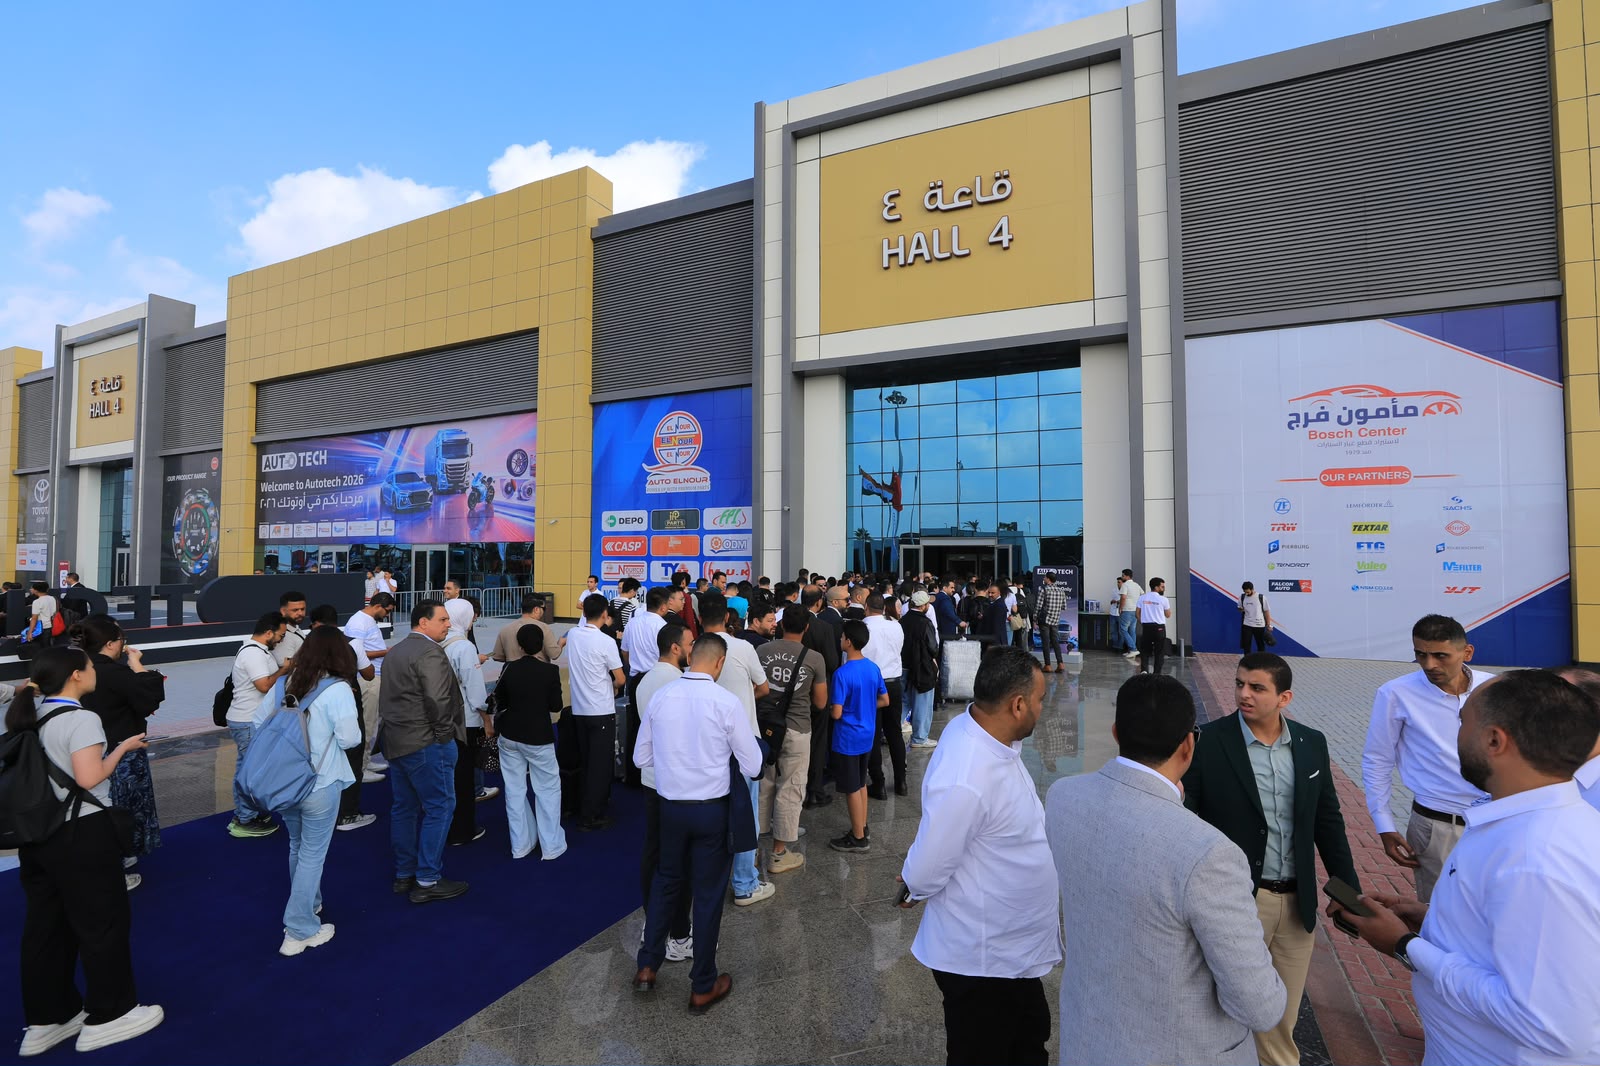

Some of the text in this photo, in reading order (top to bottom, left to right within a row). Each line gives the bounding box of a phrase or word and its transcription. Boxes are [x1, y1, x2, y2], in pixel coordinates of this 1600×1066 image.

[882, 169, 1013, 222] قاعة ٤
[882, 214, 1014, 270] HALL 4
[90, 375, 122, 396] قاعة ٤
[90, 397, 122, 419] HALL 4
[1287, 397, 1419, 431] مأمون فرج
[1308, 426, 1407, 440] Bosch Center
[262, 449, 328, 472] AUTO TECH
[176, 473, 193, 481] PRODUCT
[193, 472, 207, 480] RANGE
[648, 478, 671, 486] AUTO
[1320, 470, 1410, 482] OUR PARTNERS
[260, 474, 364, 492] Welcome to Autotech 2026
[260, 492, 364, 512] مرحبا بكم في أوتوتك ٢٠٢٦
[1275, 500, 1289, 512] ZF
[618, 516, 644, 525] DEPO
[1270, 522, 1298, 532] TRW
[1352, 524, 1389, 532] TEXTAR
[614, 541, 642, 552] CASP
[722, 539, 748, 550] ODM
[1357, 561, 1387, 571] Valeo
[772, 666, 792, 683] 88
